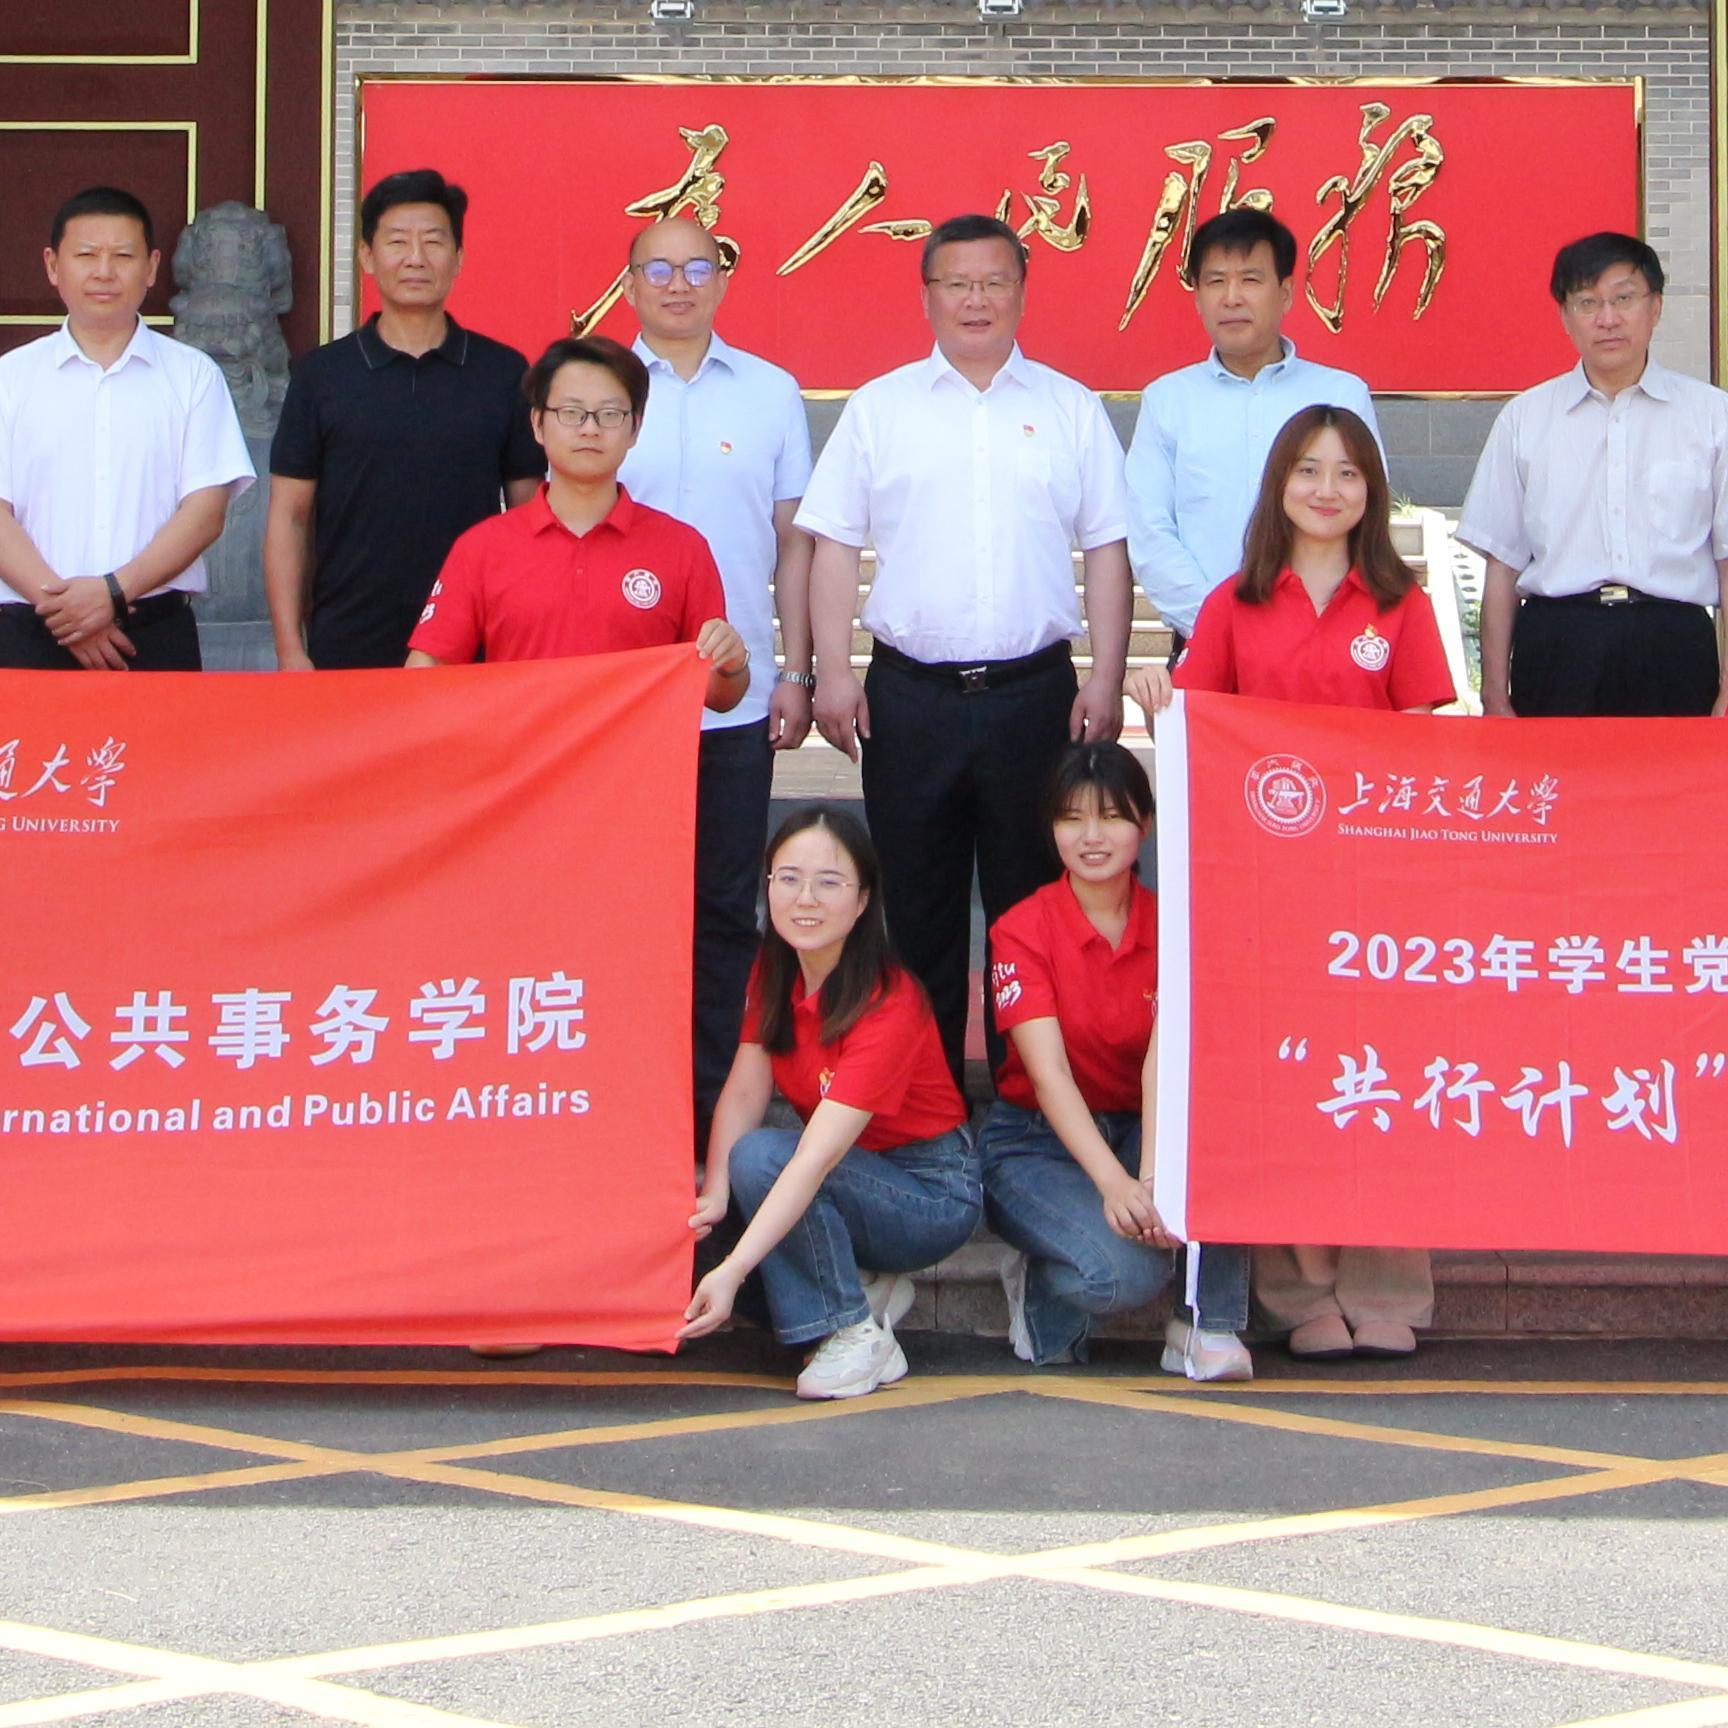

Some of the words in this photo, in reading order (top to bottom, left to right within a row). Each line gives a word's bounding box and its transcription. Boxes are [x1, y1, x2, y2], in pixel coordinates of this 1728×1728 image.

[12, 815, 121, 833] UNIVERSITY
[1337, 823, 1407, 839] SHANGHAI
[1411, 827, 1438, 841] JIAO
[1441, 828, 1478, 842] TONG
[1481, 830, 1558, 844] UNIVERSITY
[992, 962, 1016, 987] jtu
[213, 1095, 291, 1130] and
[303, 1090, 435, 1127] Public
[446, 1083, 591, 1121] Affairs
